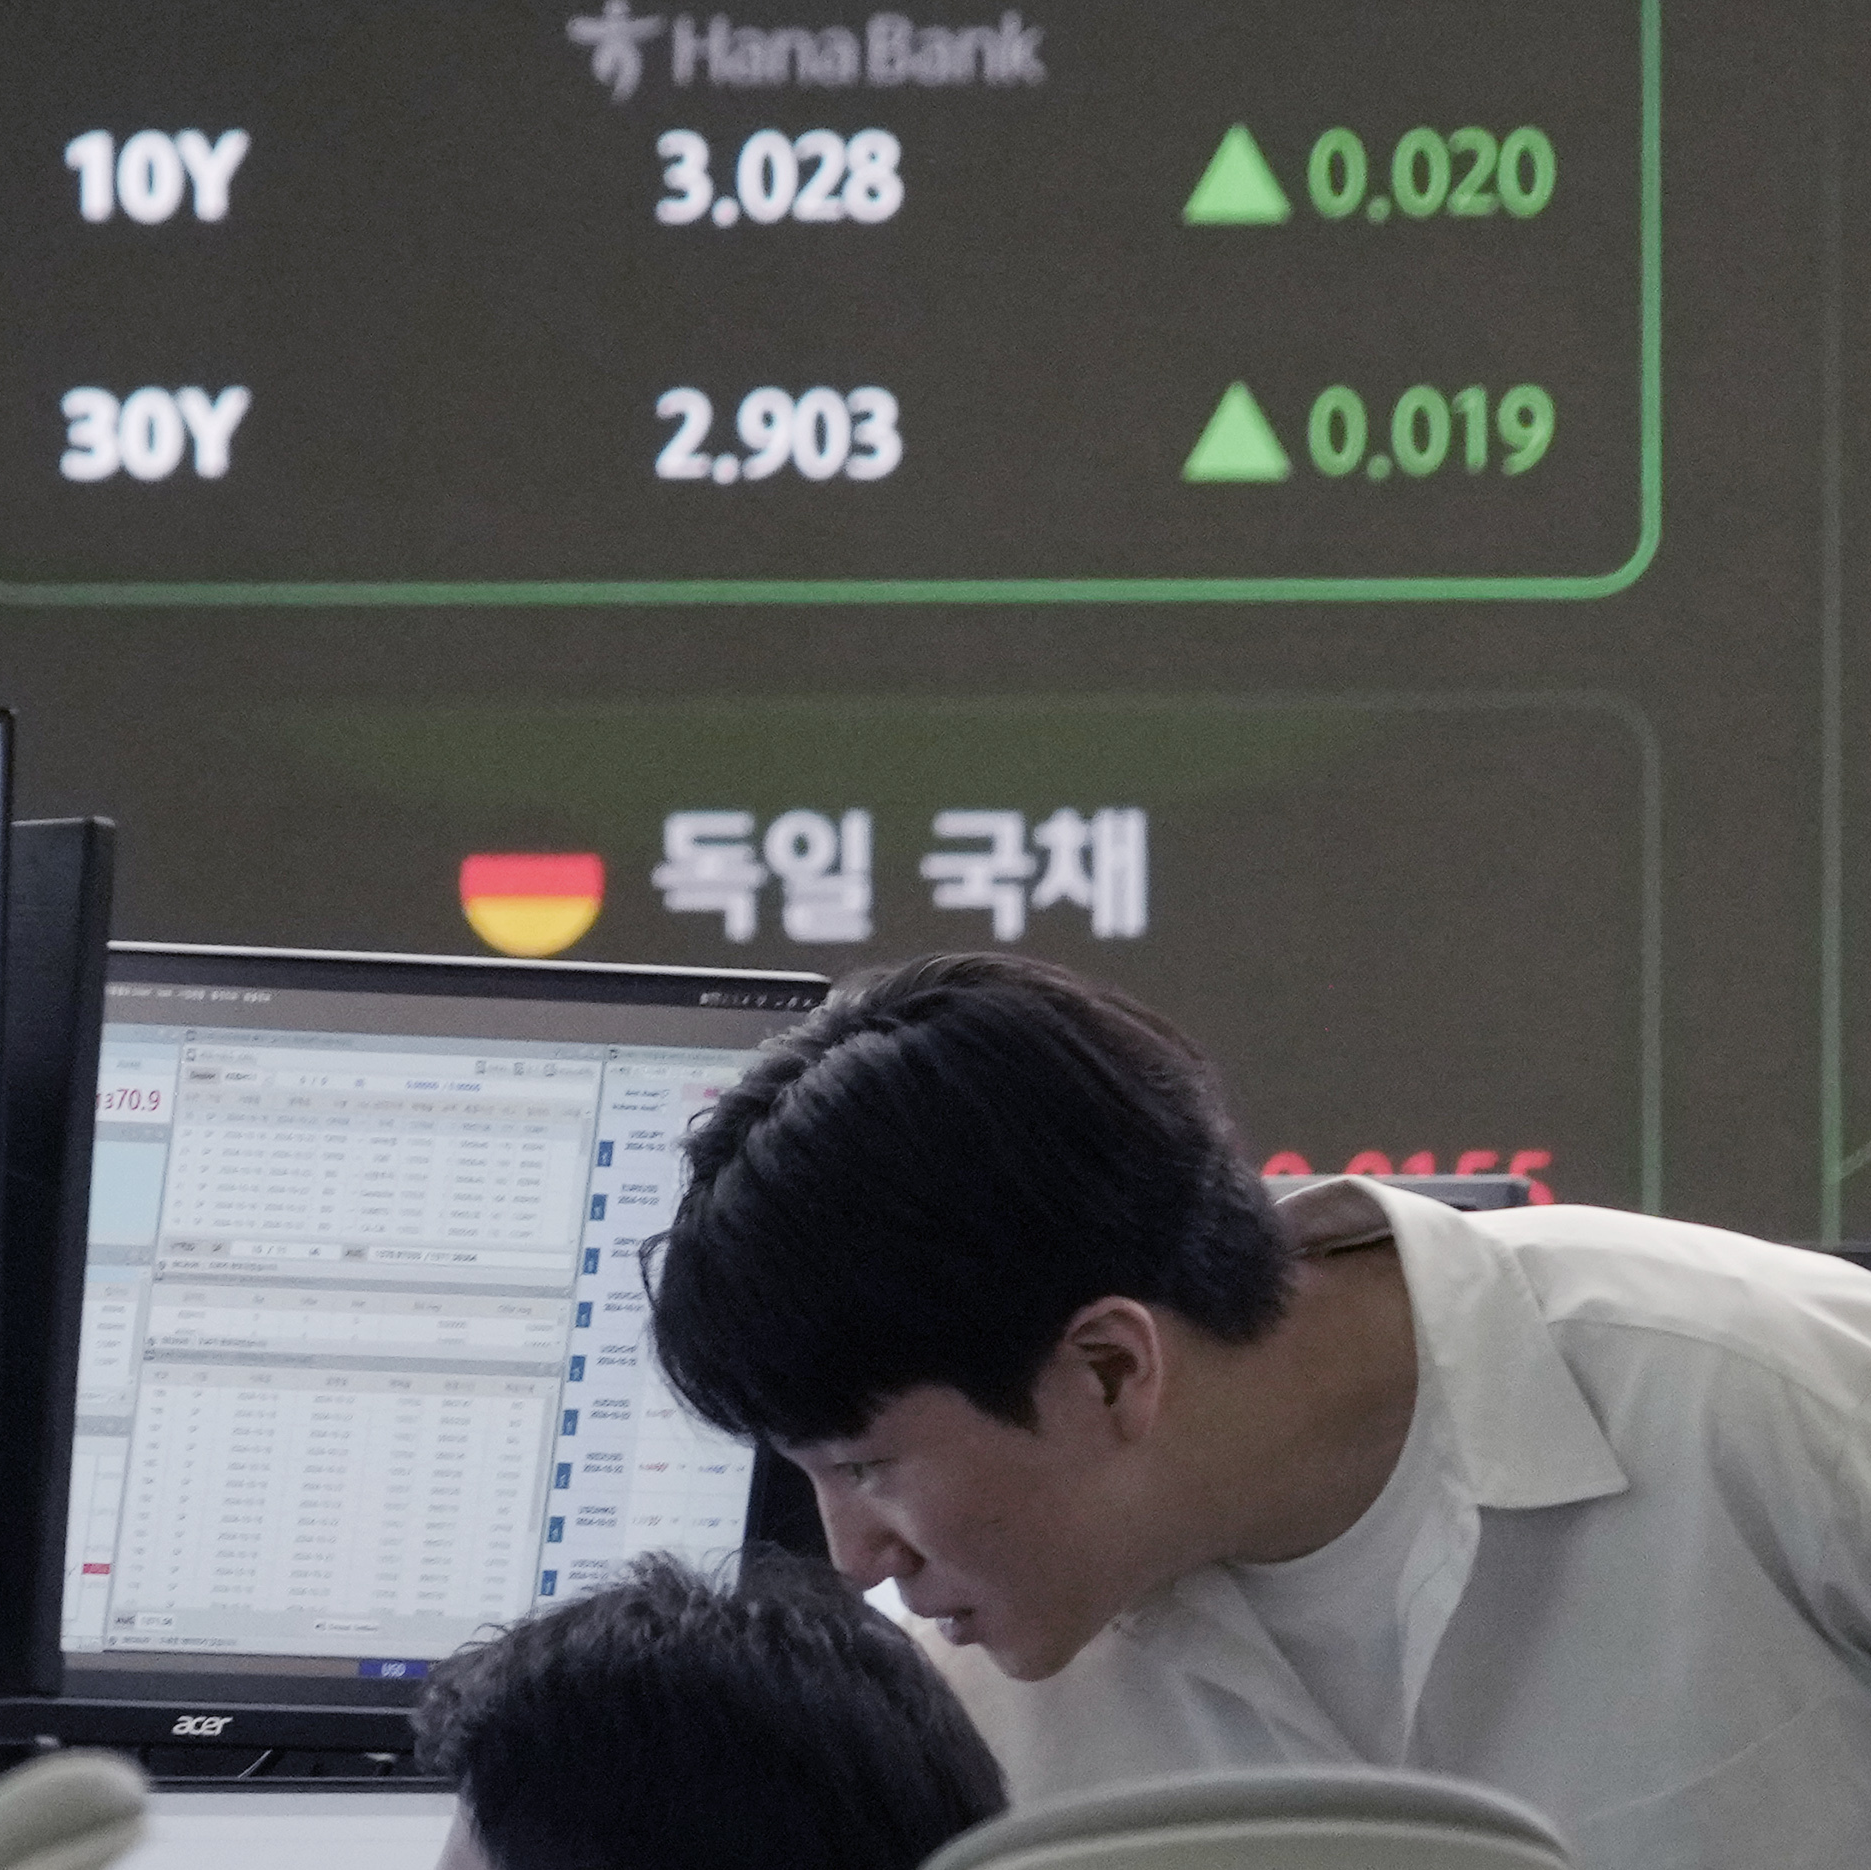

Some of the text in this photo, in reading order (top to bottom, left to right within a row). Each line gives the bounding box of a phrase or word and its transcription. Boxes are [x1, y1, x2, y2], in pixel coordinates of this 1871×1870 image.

[63, 125, 1558, 229] 10Y 3.028 0.020
[59, 382, 1558, 486] 30Y 2.903 0.019
[651, 807, 1149, 944] 독일 국채
[171, 1714, 234, 1737] acer
